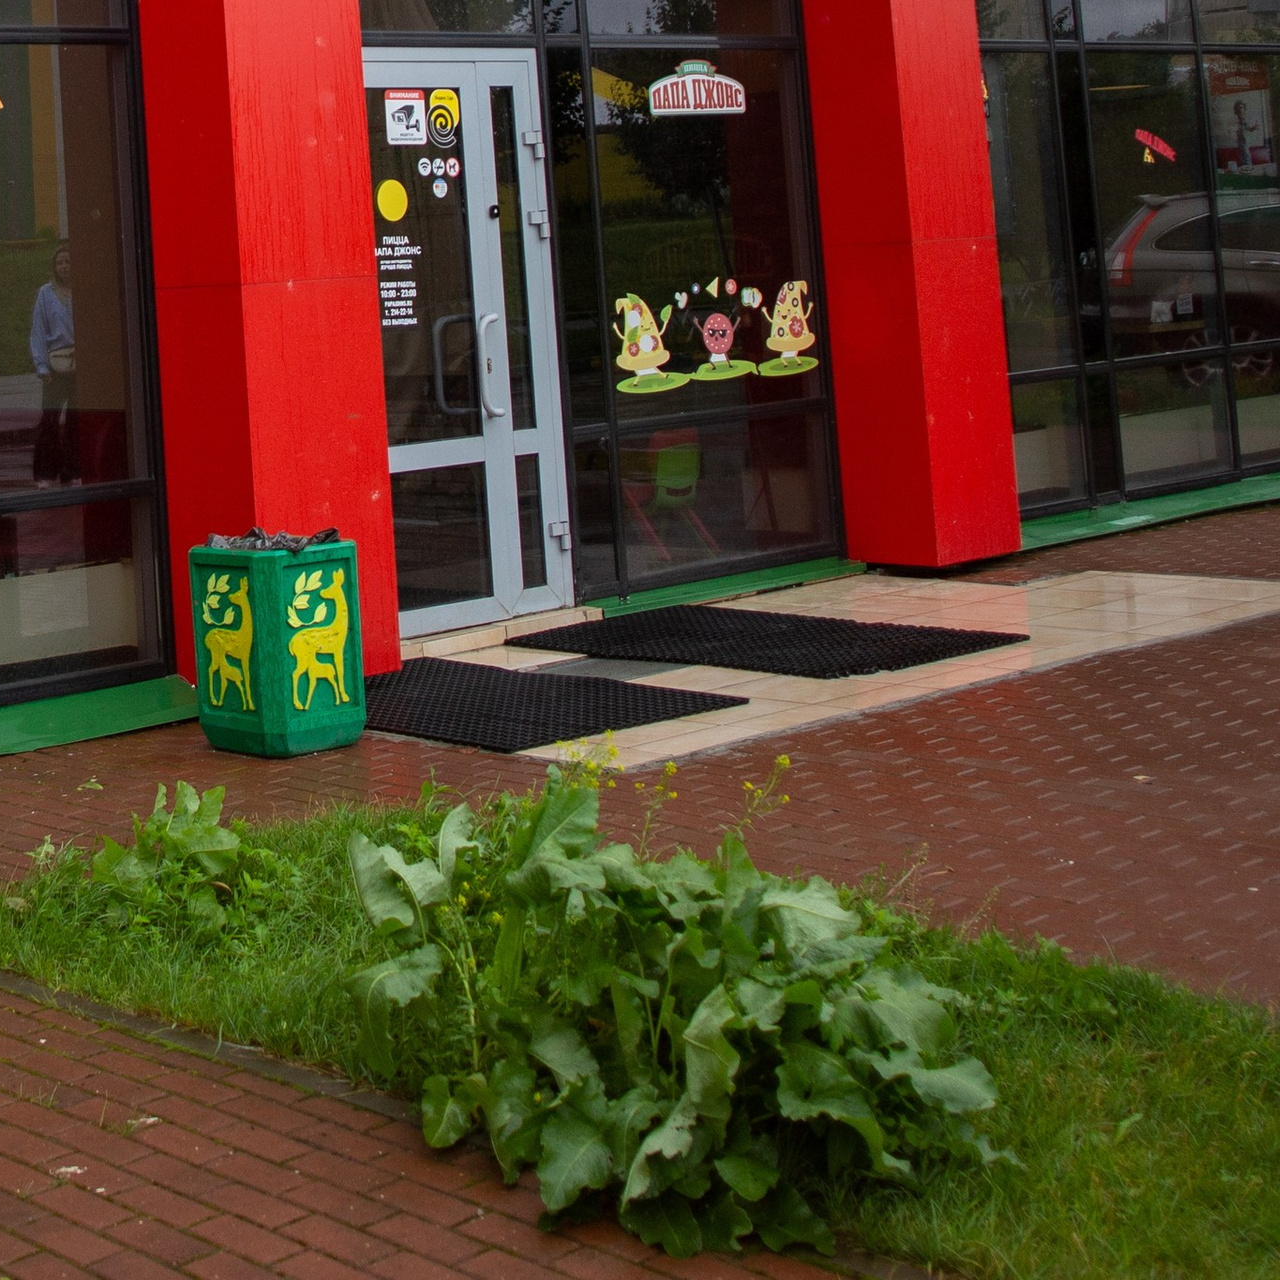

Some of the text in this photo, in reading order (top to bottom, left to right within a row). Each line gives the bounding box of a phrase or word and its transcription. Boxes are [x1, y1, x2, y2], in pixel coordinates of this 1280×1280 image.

[652, 79, 690, 109] ПАПА
[382, 235, 410, 245] ПИЦЦА
[394, 246, 422, 257] ДЖОНС
[380, 289, 397, 298] 10:00
[400, 289, 417, 297] 23:00
[382, 317, 418, 326] БЕЗ ВЫХОДНЫХ
